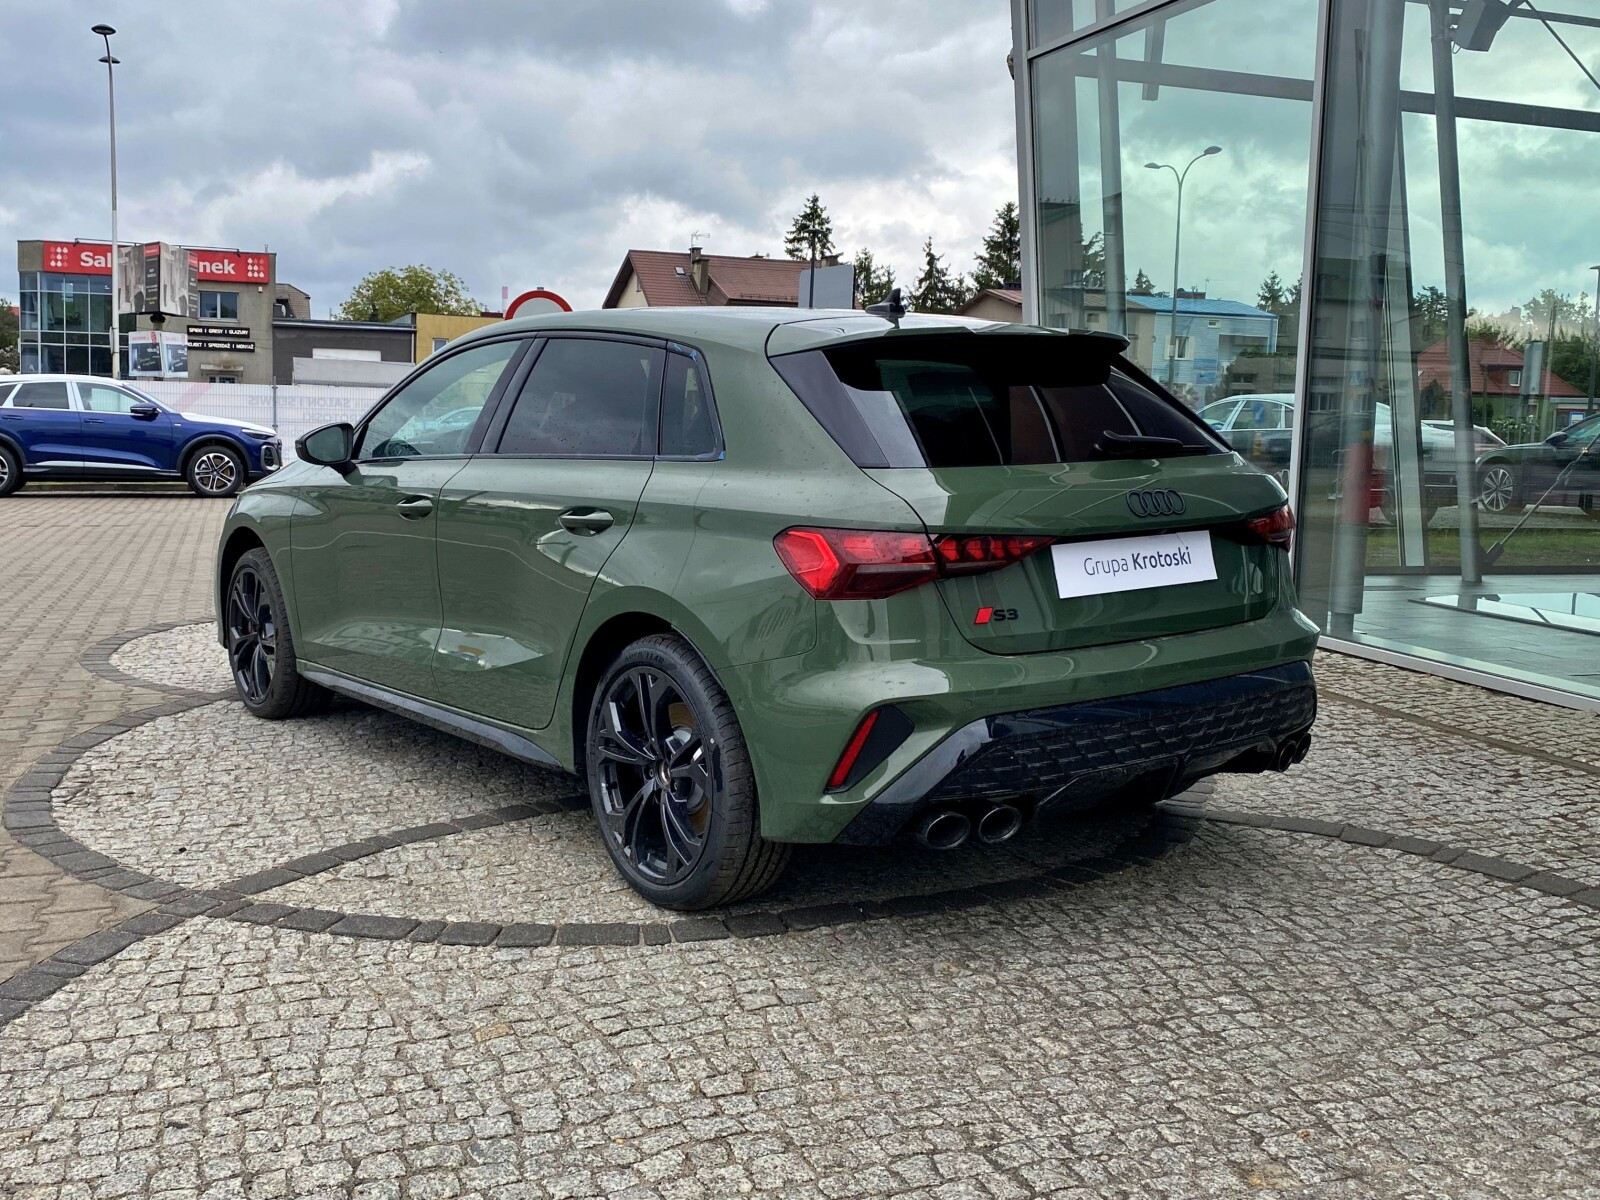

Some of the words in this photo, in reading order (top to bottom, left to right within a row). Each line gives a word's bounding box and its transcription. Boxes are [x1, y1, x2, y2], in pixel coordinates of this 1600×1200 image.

[80, 251, 112, 268] Sal
[1083, 556, 1129, 578] Grupa
[1131, 545, 1192, 571] Krotoski
[992, 608, 1019, 622] S3
